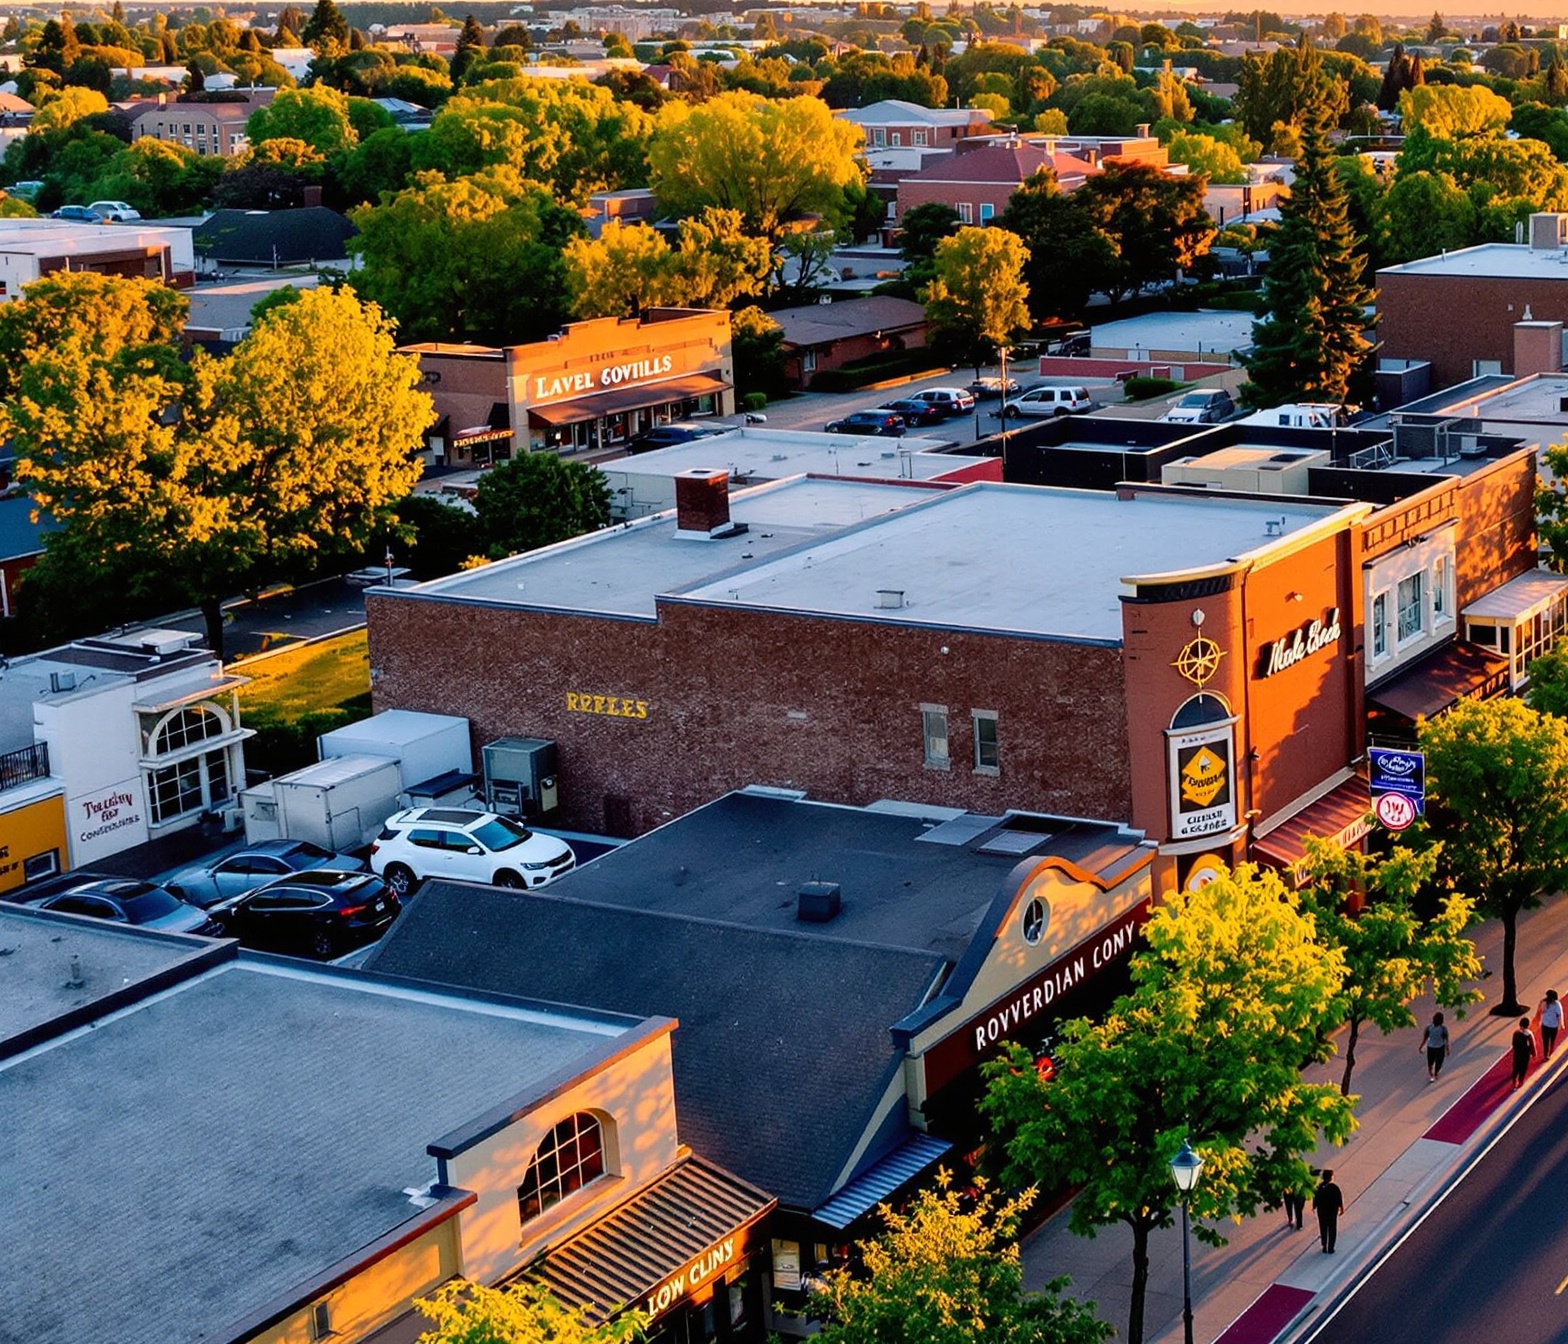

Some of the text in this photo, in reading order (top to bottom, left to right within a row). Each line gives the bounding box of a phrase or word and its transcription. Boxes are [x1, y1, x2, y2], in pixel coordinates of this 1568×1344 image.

[536, 373, 595, 399] LAVEL
[1093, 920, 1135, 968] CONY
[647, 1274, 685, 1316] LOW
